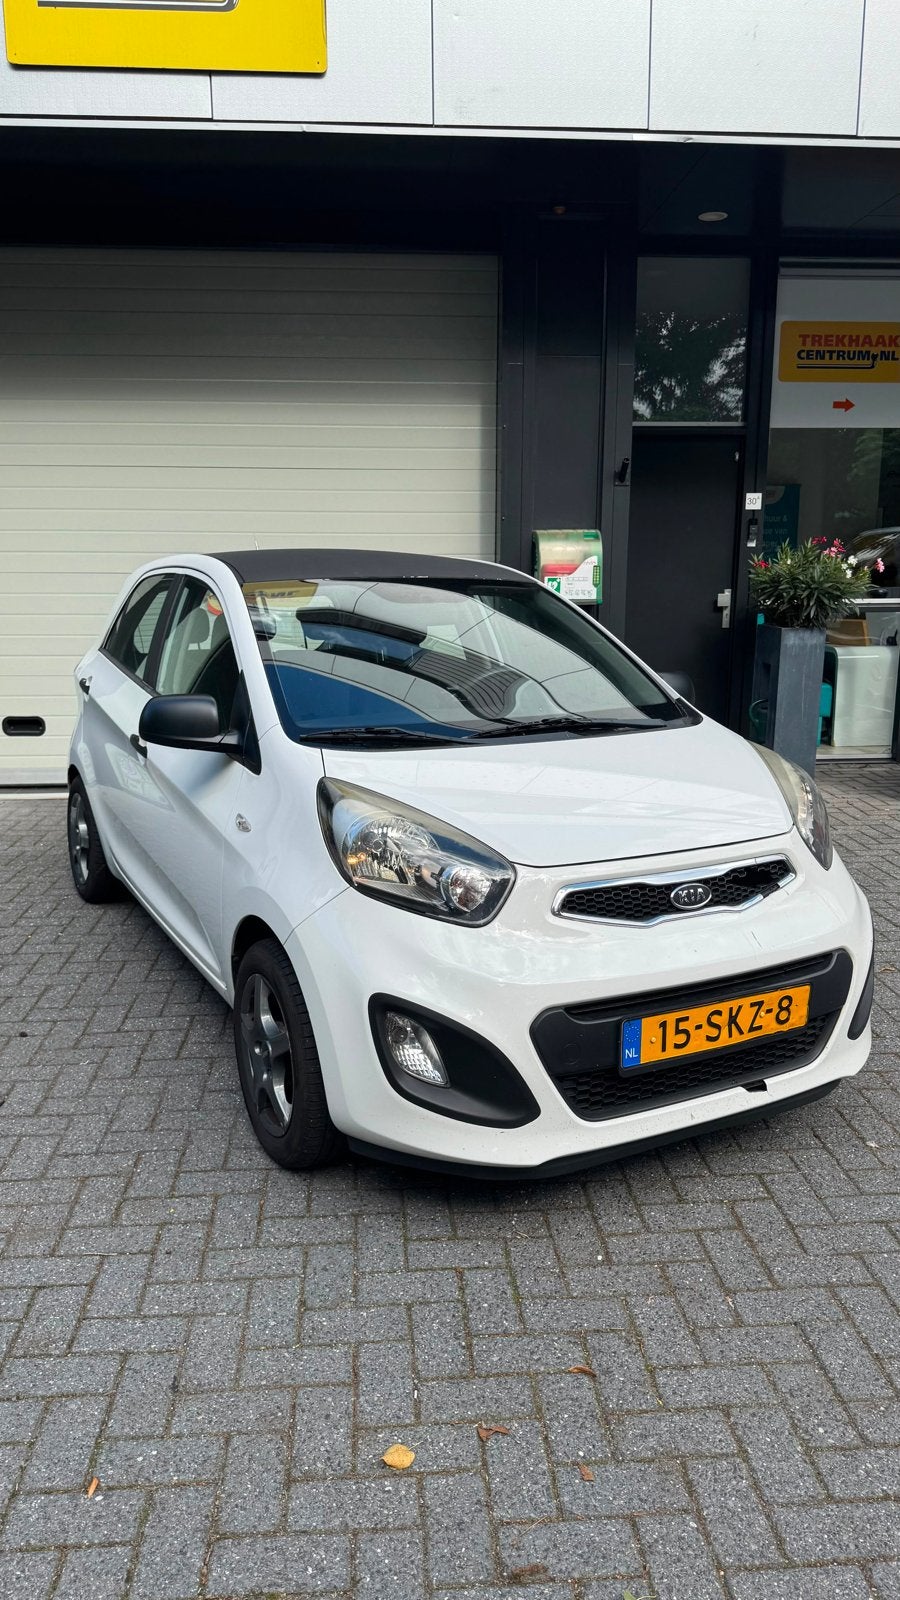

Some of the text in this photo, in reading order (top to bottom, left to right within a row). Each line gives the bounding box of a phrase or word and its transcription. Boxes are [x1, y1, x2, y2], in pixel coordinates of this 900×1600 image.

[798, 334, 900, 348] TREKHAAK
[677, 887, 706, 903] KIA
[658, 995, 793, 1053] 15-SKZ-8
[625, 1048, 638, 1059] NL
